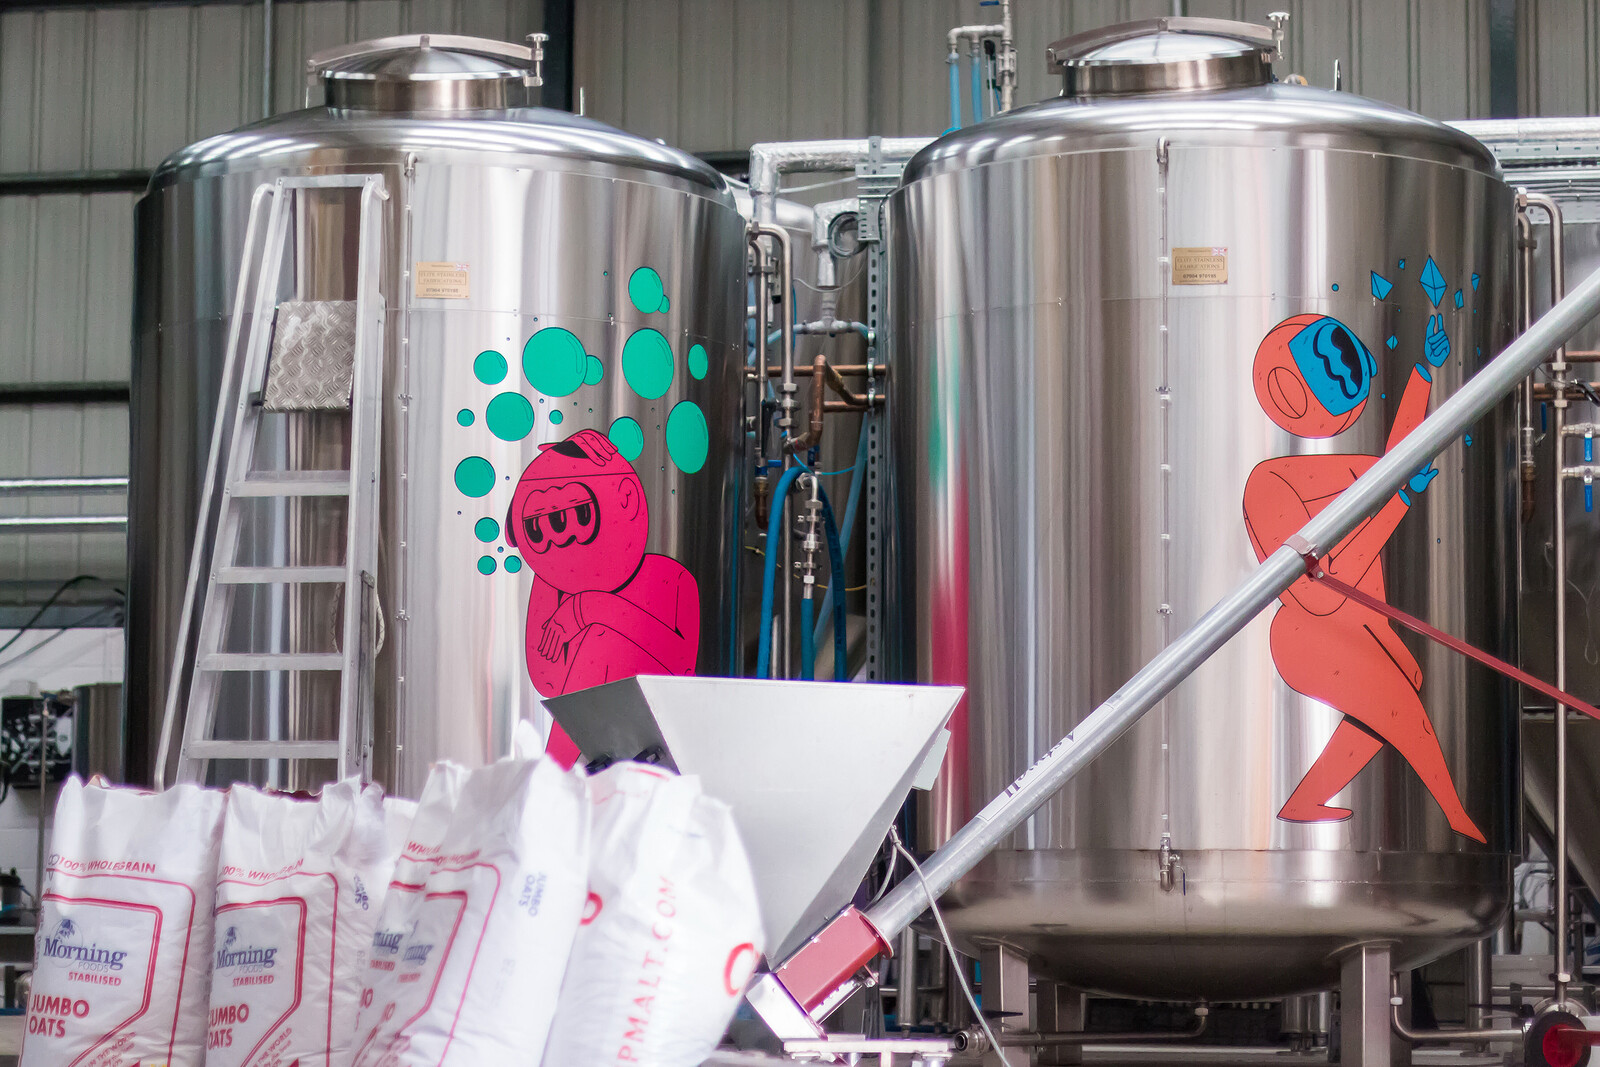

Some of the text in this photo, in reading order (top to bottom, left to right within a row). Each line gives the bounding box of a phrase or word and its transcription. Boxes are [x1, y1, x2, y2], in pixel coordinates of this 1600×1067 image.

[60, 856, 87, 872] 100%
[87, 860, 156, 874] WHOLEGRAIN
[43, 938, 128, 971] Morning
[215, 945, 278, 969] Morning
[68, 971, 122, 987] STABILISED
[78, 961, 109, 973] FOODS
[615, 875, 677, 1067] PMALT.COM
[232, 975, 275, 987] STABILISED
[31, 994, 90, 1019] JUMBO
[29, 1015, 66, 1039] OATS
[207, 1027, 233, 1051] OATS
[267, 1027, 293, 1052] WORLD
